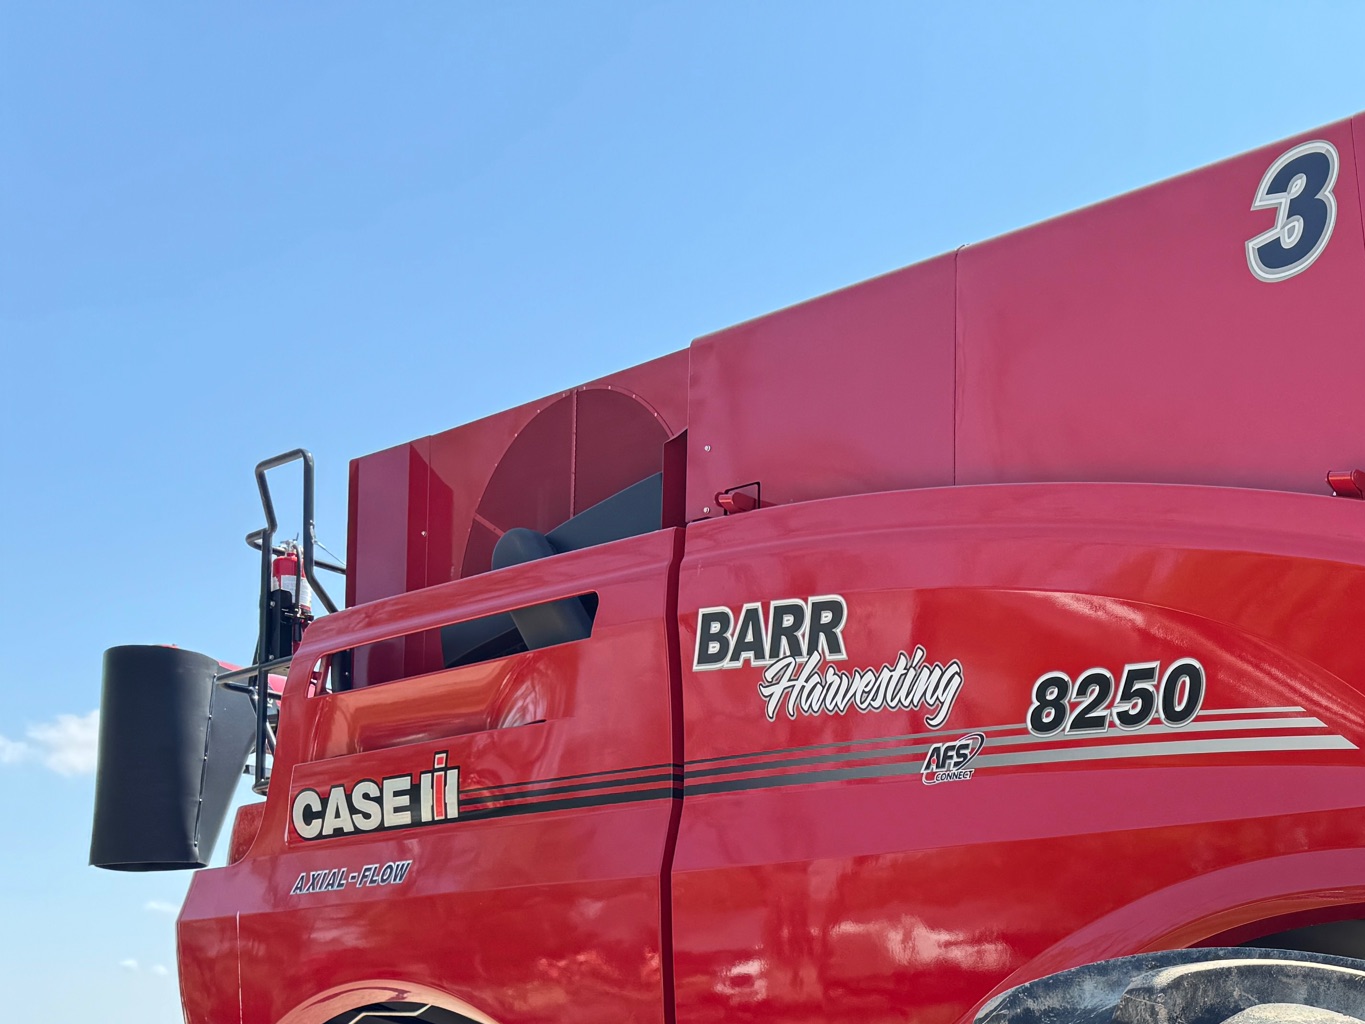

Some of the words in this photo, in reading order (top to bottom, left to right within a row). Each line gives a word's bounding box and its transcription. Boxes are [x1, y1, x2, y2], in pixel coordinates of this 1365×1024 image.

[1245, 139, 1340, 283] 3
[692, 594, 848, 672] BARR
[758, 644, 964, 729] Harvesting
[1025, 657, 1206, 737] 8250
[920, 739, 974, 773] AFS
[935, 769, 974, 782] CONNECT
[292, 776, 412, 839] CASE
